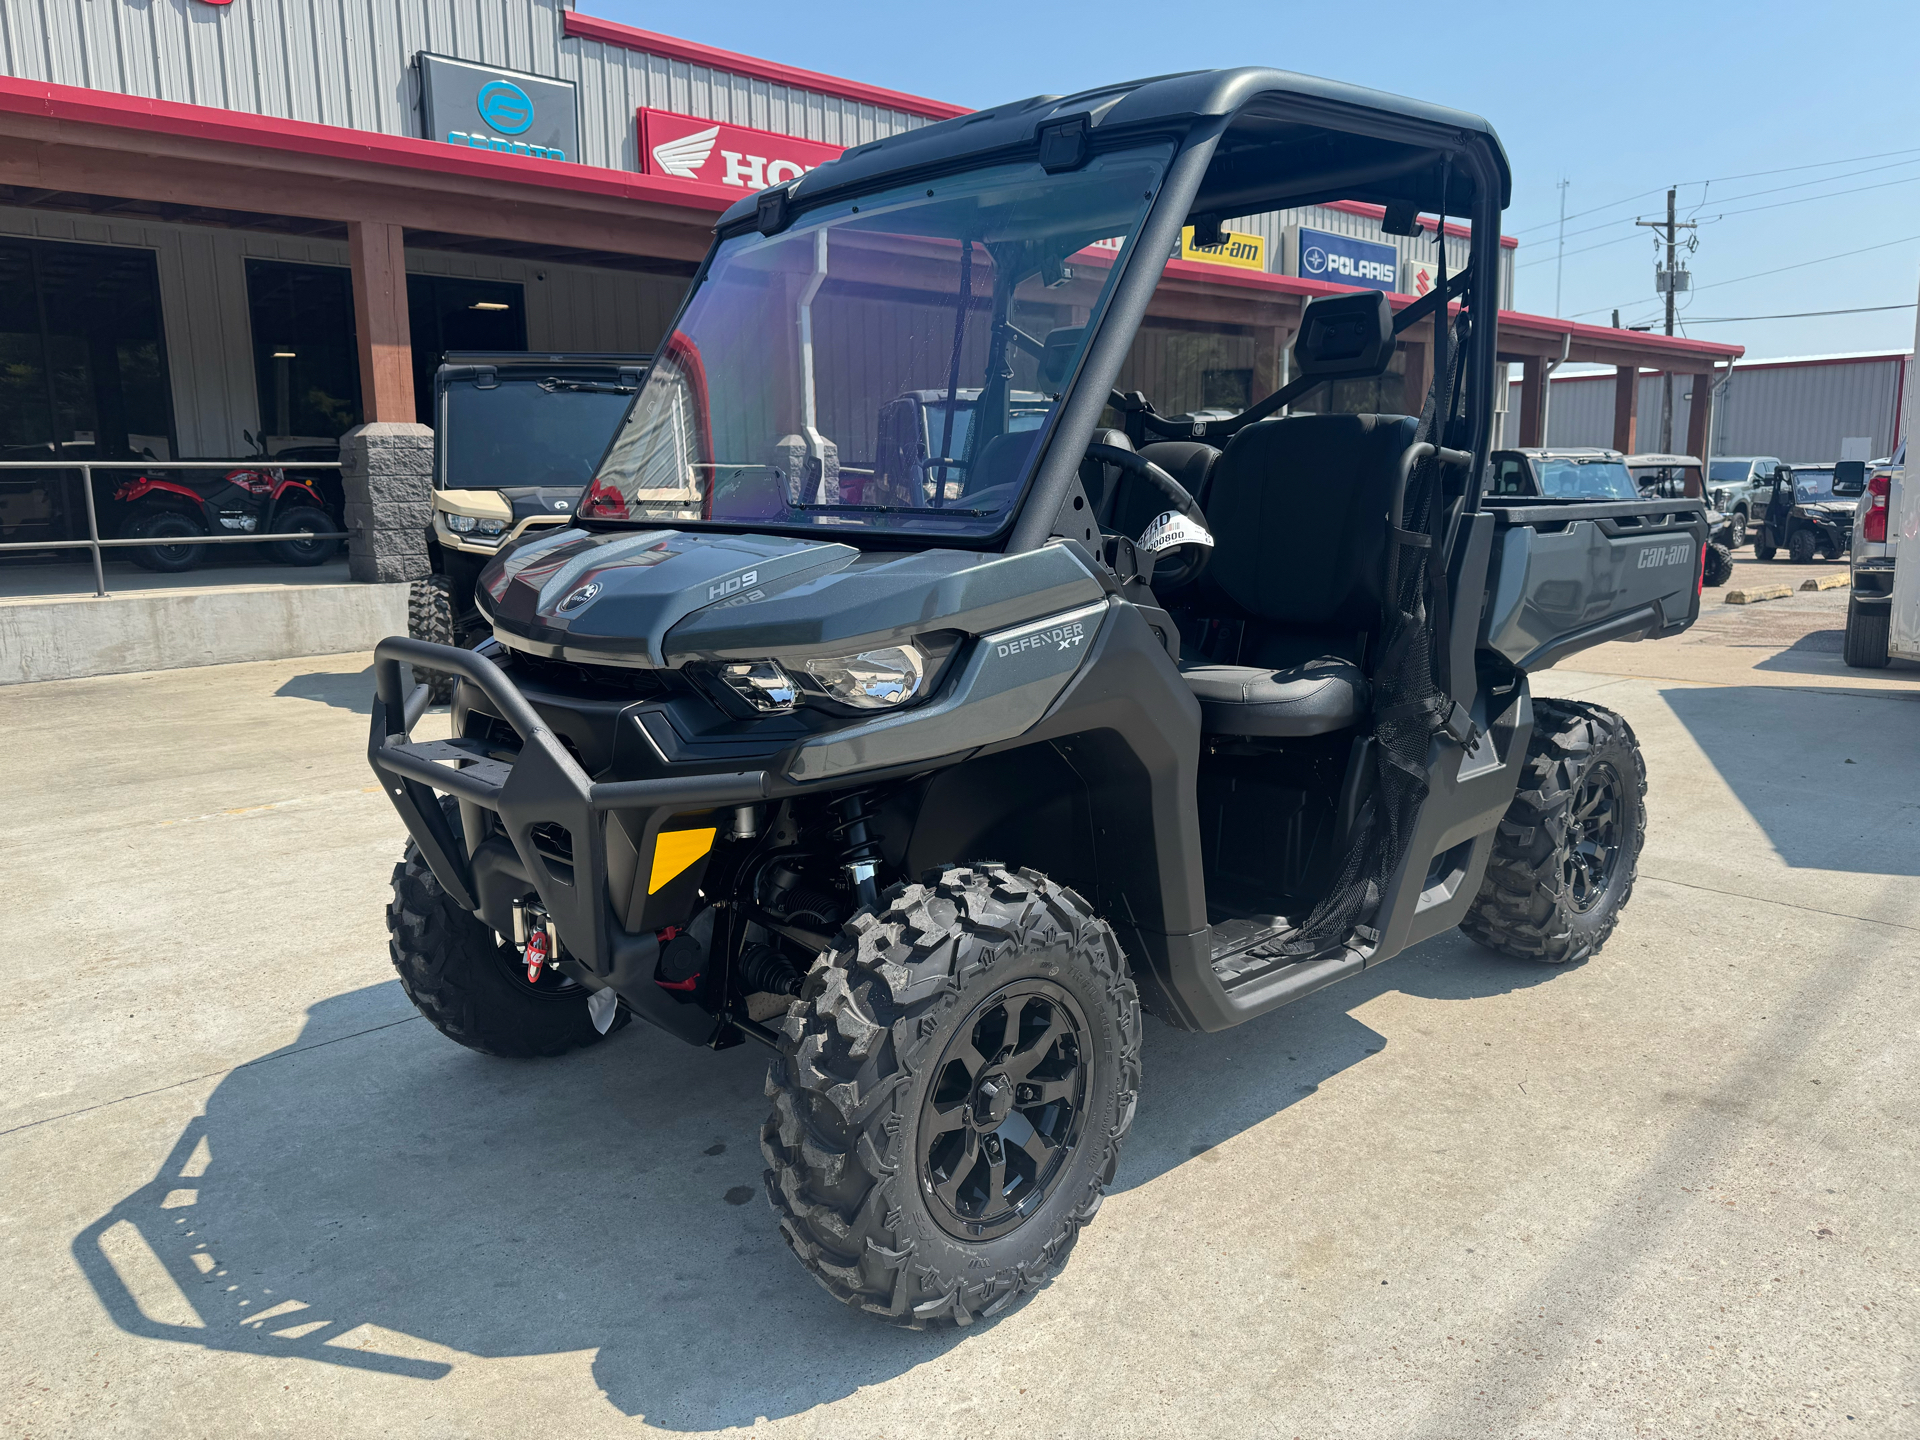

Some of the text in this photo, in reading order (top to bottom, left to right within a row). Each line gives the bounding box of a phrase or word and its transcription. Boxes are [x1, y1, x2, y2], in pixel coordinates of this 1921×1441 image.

[721, 150, 816, 190] HO
[1327, 253, 1394, 283] POLARIS
[709, 570, 758, 600] HD9
[997, 623, 1083, 658] DEFENDER
[1058, 635, 1084, 651] XT
